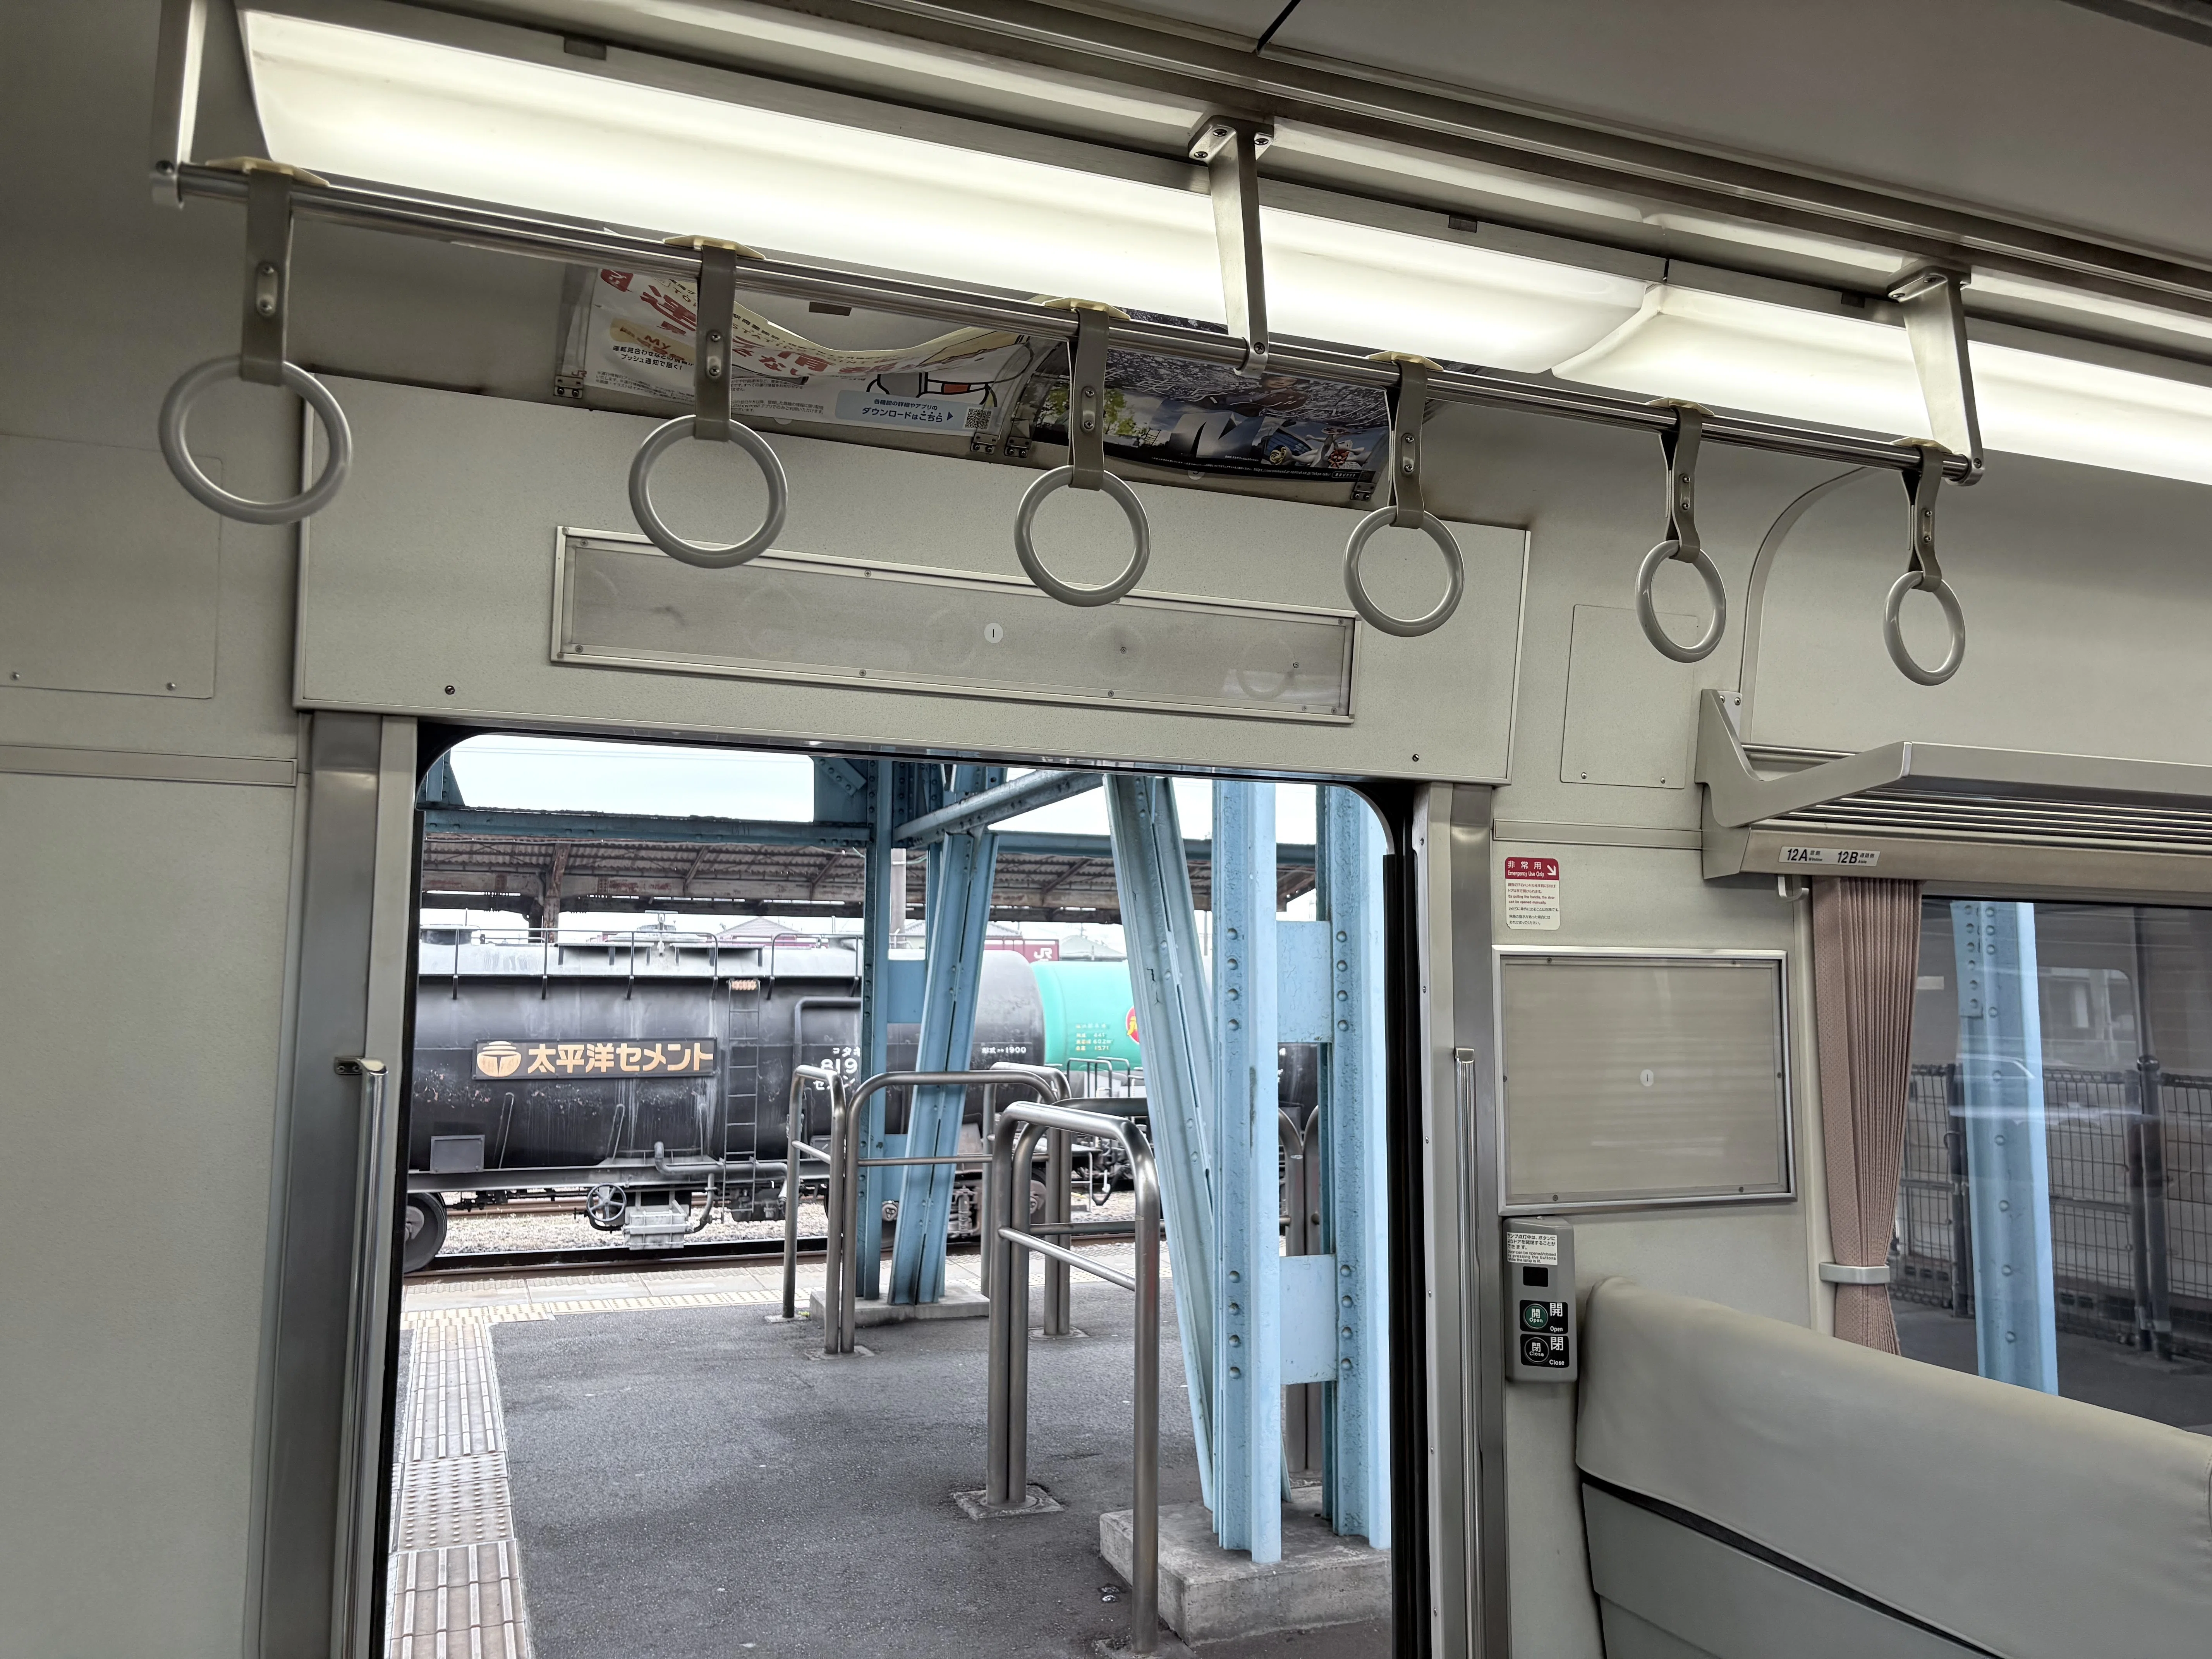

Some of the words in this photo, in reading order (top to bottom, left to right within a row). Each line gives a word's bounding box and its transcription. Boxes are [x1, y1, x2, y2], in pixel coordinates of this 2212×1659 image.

[862, 407, 943, 423] ダウンロードはこちら
[1787, 848, 1808, 862] 12A
[1837, 851, 1859, 864] 12B
[1508, 860, 1541, 870] 非常用
[1033, 947, 1053, 959] JR
[527, 1042, 714, 1073] 太平洋セメント
[1531, 1308, 1540, 1318] 開
[1550, 1302, 1563, 1317] 開
[1532, 1342, 1541, 1352] 閉
[1551, 1336, 1564, 1351] 閉
